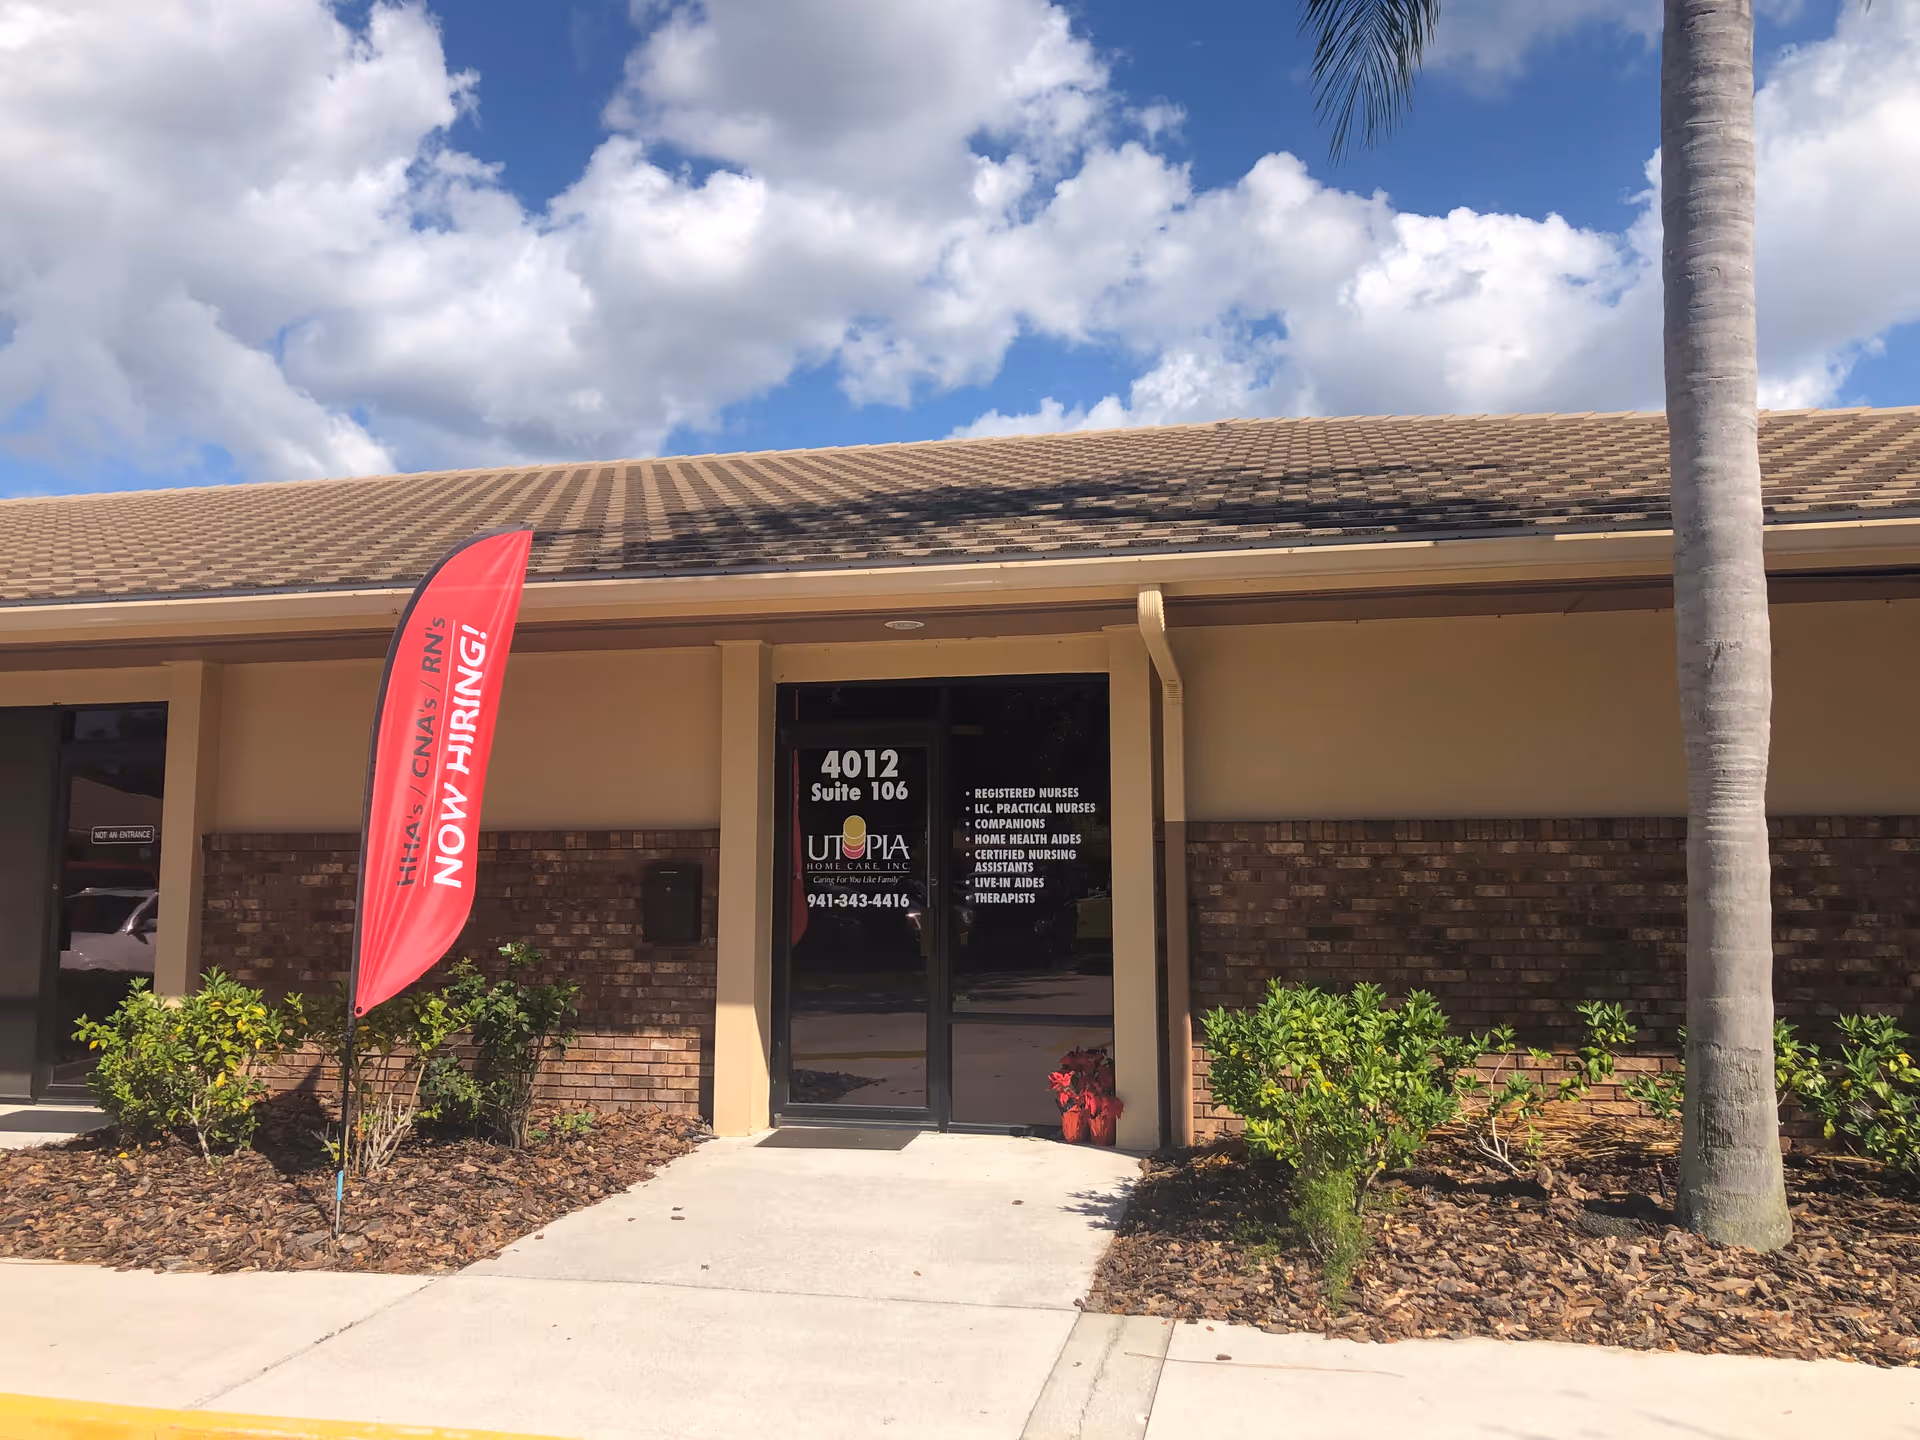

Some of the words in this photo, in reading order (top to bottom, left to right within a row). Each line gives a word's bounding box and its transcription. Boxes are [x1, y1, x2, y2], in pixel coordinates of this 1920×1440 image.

[421, 616, 445, 673] RN's
[446, 624, 487, 775] HIRING!
[411, 697, 437, 778] CNA's
[821, 749, 899, 778] 4012
[811, 781, 861, 801] Suite
[871, 781, 908, 800] 106
[974, 787, 1036, 799] REGISTERED
[1039, 787, 1079, 798] NURSES
[974, 803, 993, 814] LIC.
[996, 803, 1053, 814] PRACTICAL
[1055, 802, 1096, 814] NURSES
[974, 818, 1046, 829] COMPANIONS
[94, 831, 107, 839] NOT
[119, 830, 151, 838] ENTRANCE
[433, 782, 468, 888] NOW
[807, 815, 910, 860] UTOPIA
[974, 834, 1006, 845] HOME
[1009, 834, 1047, 845] HEALTH
[1051, 833, 1082, 844] AIDES
[397, 803, 424, 886] HHA's
[974, 849, 1025, 860] CERTIFIED
[1028, 849, 1077, 860] NURSING
[806, 862, 841, 870] HOME
[974, 862, 1034, 873] ASSISTANTS
[813, 875, 835, 886] Caring
[836, 876, 848, 884] For
[849, 876, 861, 884] You
[862, 875, 876, 884] Like
[974, 877, 1011, 888] LIVE-IN
[1014, 877, 1045, 888] AIDES
[807, 893, 910, 908] 941-343-4416
[974, 892, 1036, 904] THERAPISTS
